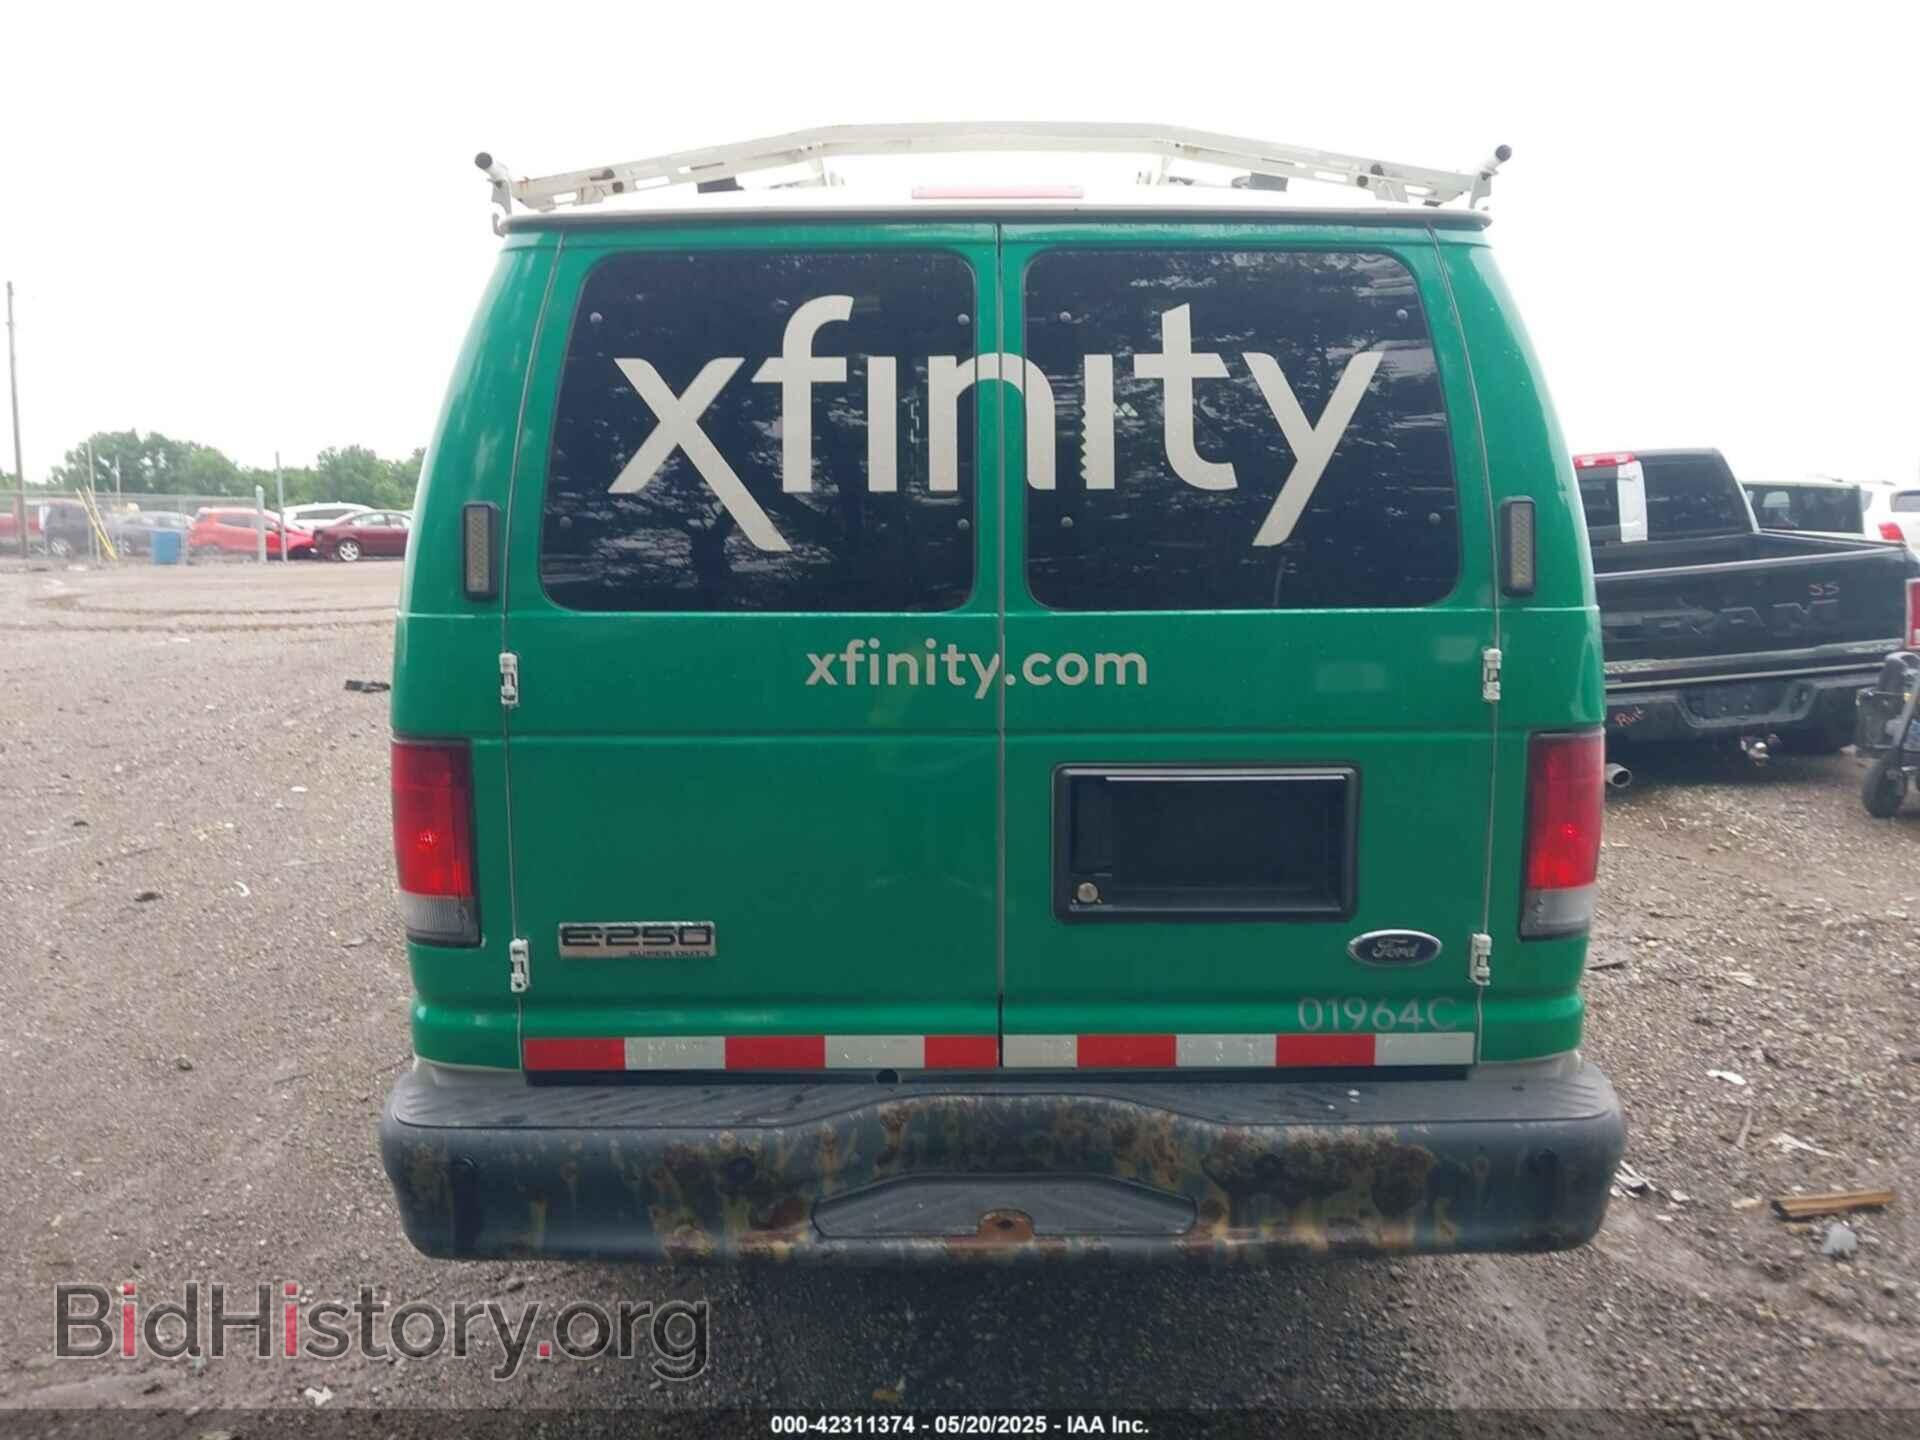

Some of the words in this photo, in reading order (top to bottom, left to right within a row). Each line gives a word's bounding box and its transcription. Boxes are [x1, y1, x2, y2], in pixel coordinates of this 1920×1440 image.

[608, 295, 1383, 551] xfinity
[805, 637, 1148, 700] xfinity.com
[1371, 938, 1420, 958] Ford
[1297, 997, 1457, 1030] 01964C
